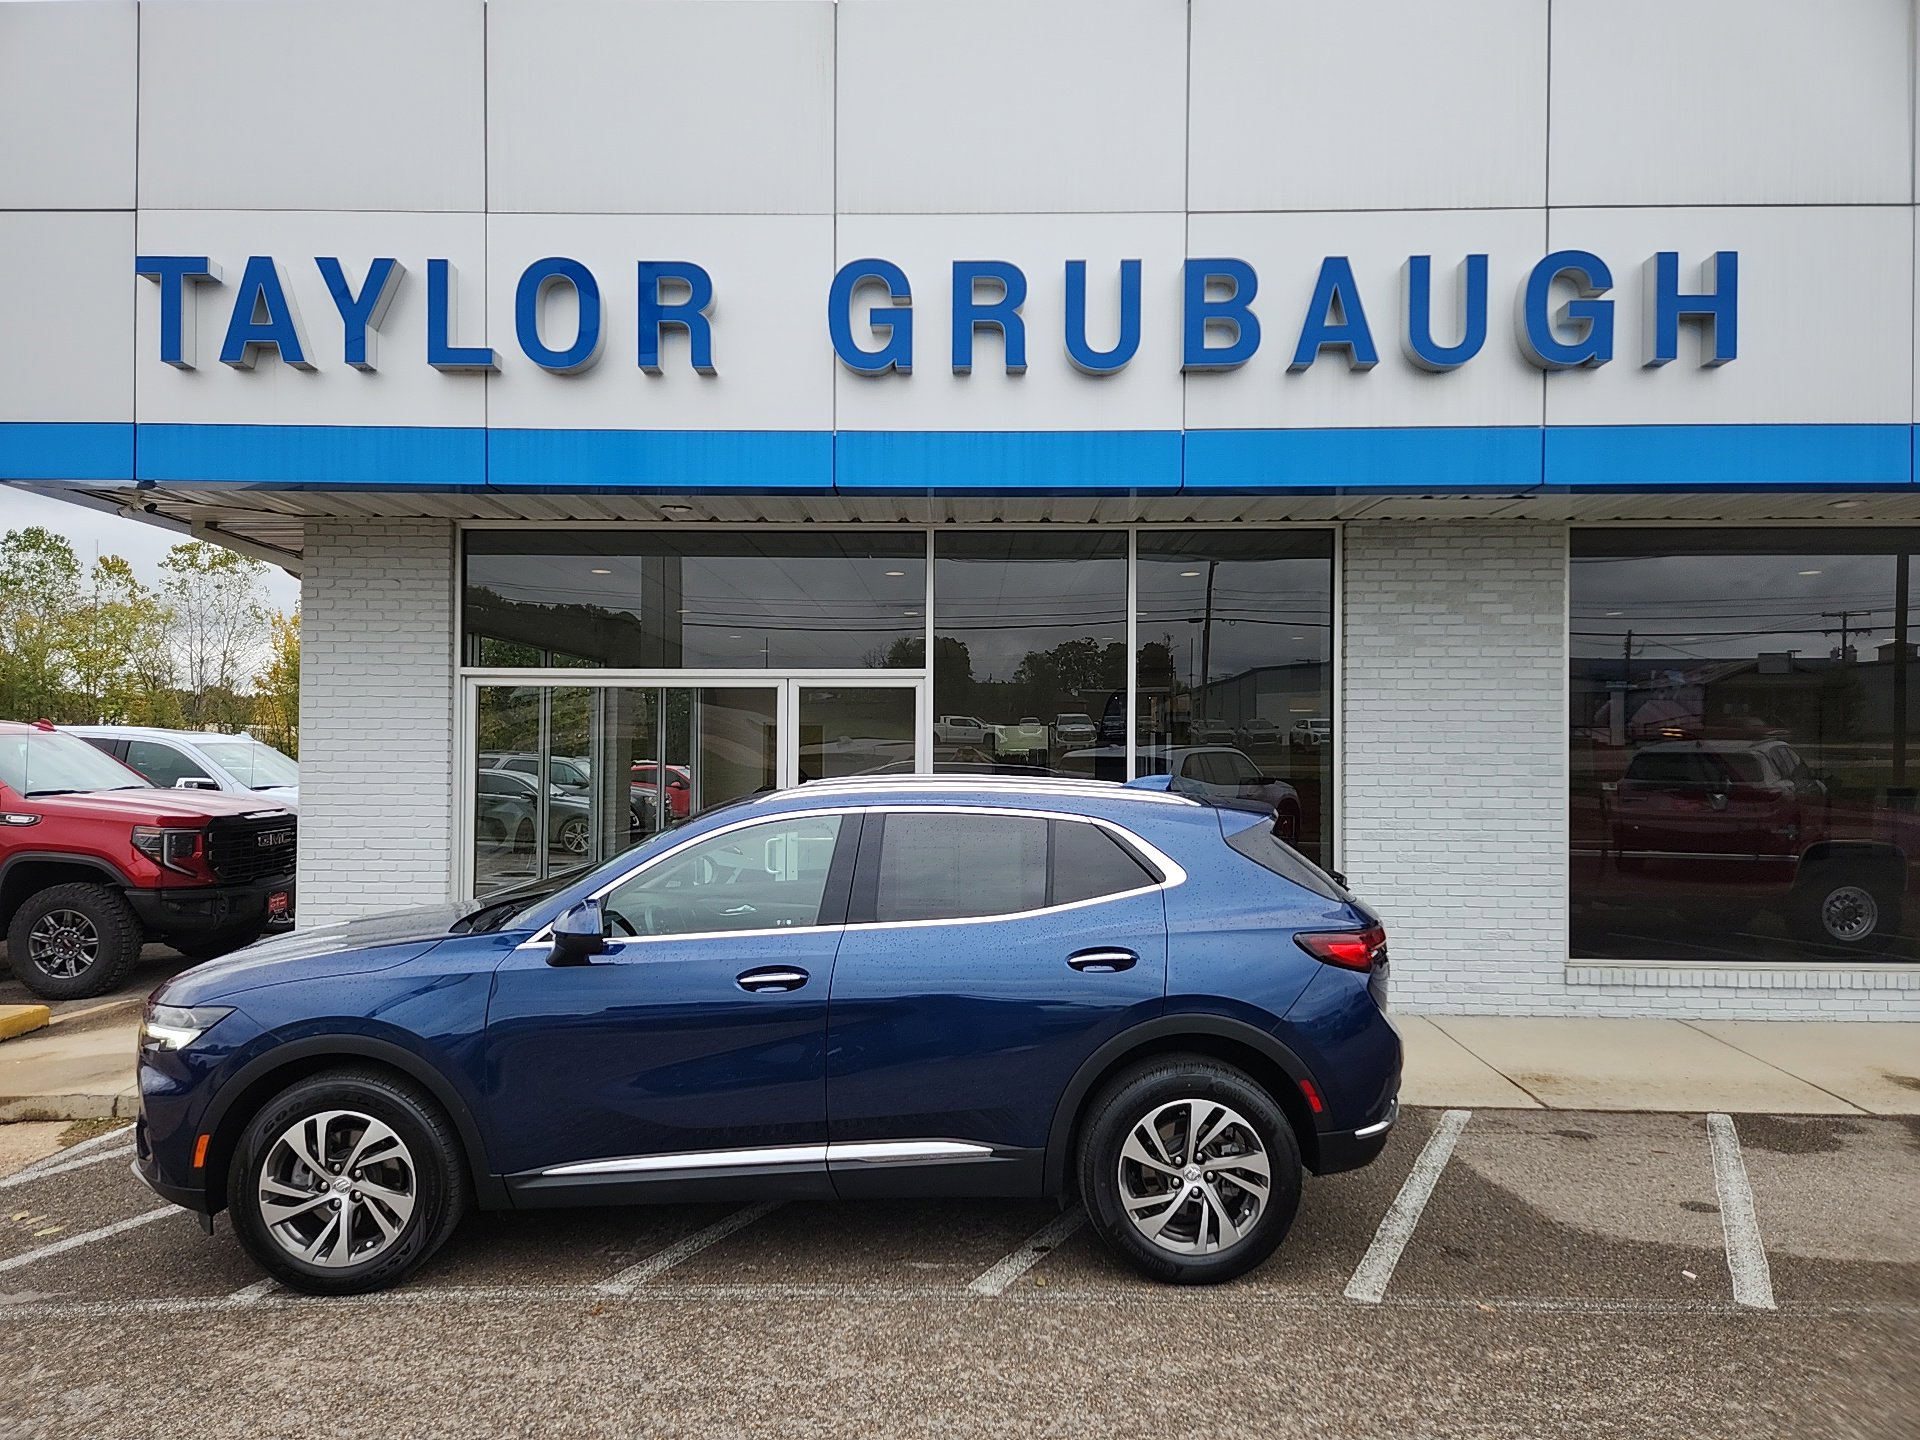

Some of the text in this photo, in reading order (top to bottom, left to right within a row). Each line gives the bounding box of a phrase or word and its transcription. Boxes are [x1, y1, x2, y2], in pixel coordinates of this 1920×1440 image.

[136, 250, 1739, 376] TAYLOR GRUBAUGH
[257, 832, 293, 847] GMC
